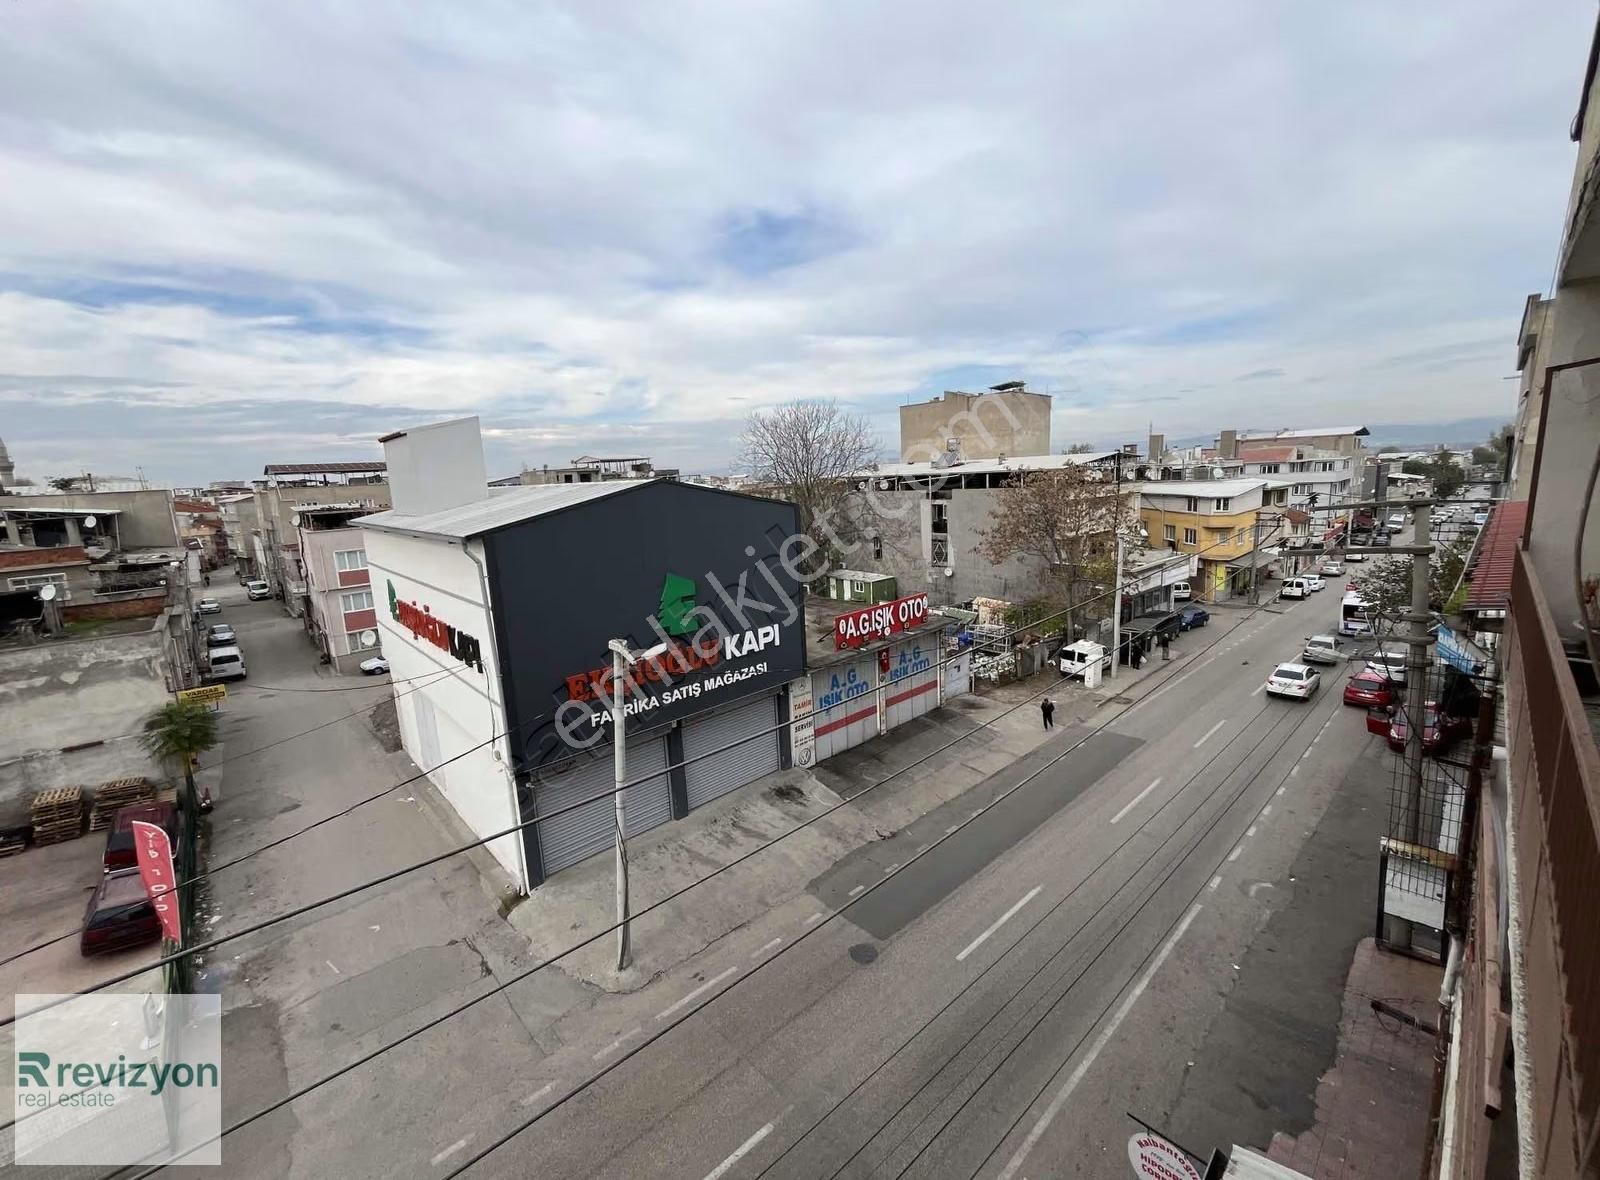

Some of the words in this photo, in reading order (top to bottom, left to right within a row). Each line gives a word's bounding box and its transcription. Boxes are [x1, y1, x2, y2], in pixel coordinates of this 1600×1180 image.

[899, 597, 923, 622] OTO
[723, 623, 780, 661] KAPI
[591, 696, 660, 728] FARİKA
[662, 682, 702, 705] SATIŞ
[704, 662, 768, 692] MAĞAZASI
